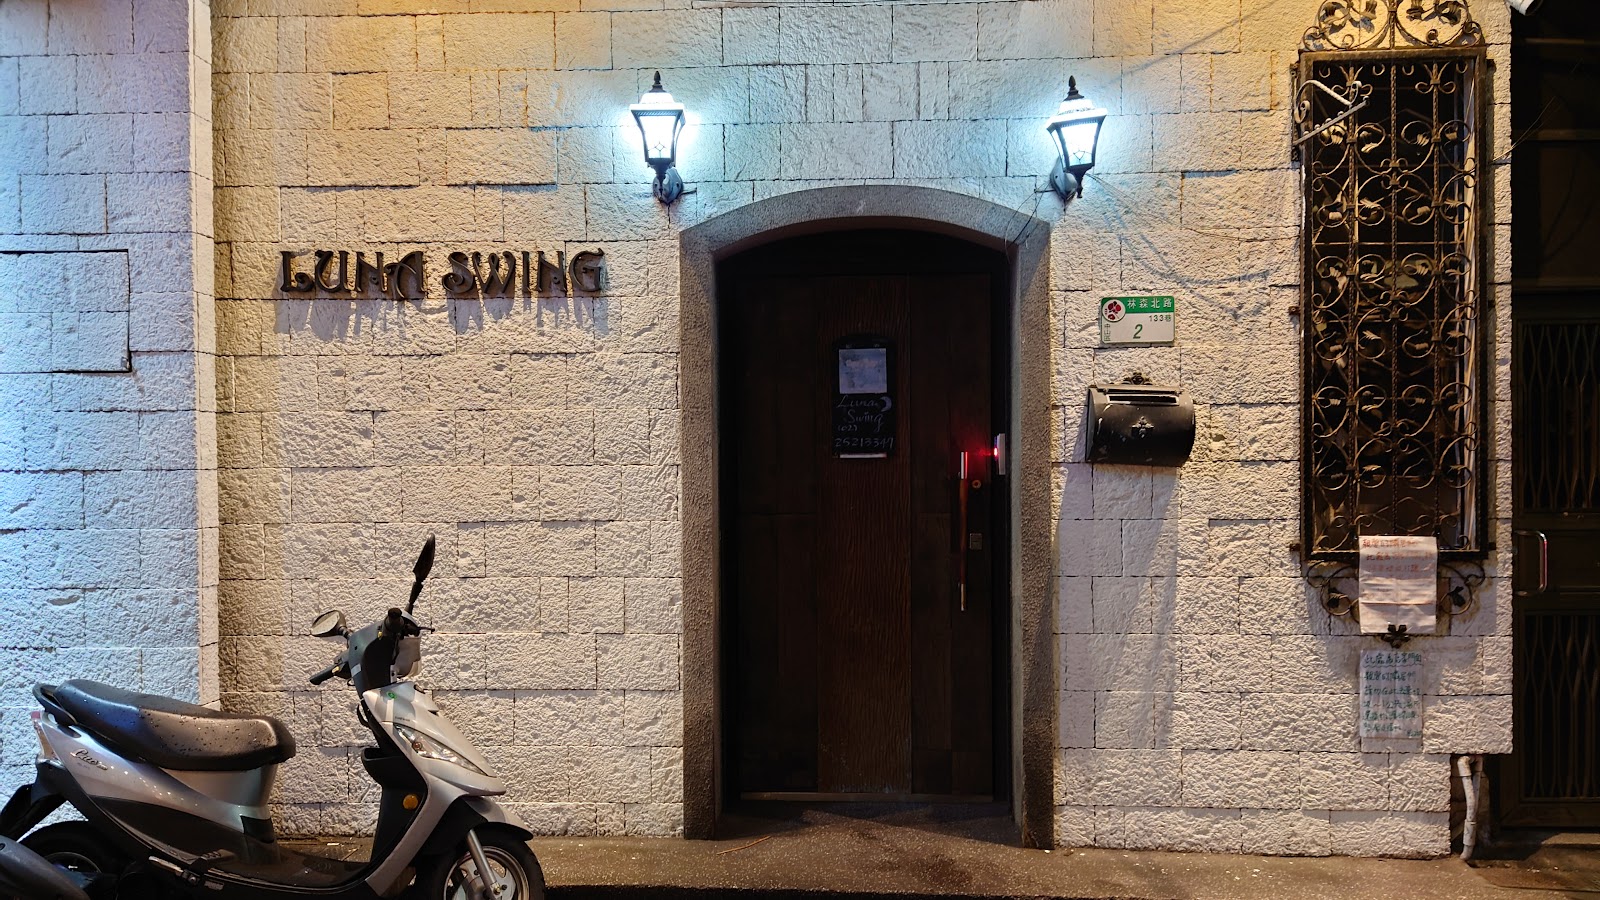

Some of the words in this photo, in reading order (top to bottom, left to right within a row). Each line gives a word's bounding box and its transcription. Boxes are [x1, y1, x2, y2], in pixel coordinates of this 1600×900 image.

[280, 249, 426, 298] LUNA
[442, 247, 605, 294] SWING
[1127, 297, 1172, 310] 林森北路
[1149, 314, 1172, 323] 133巷
[1132, 323, 1143, 340] 2
[847, 408, 883, 433] Swing
